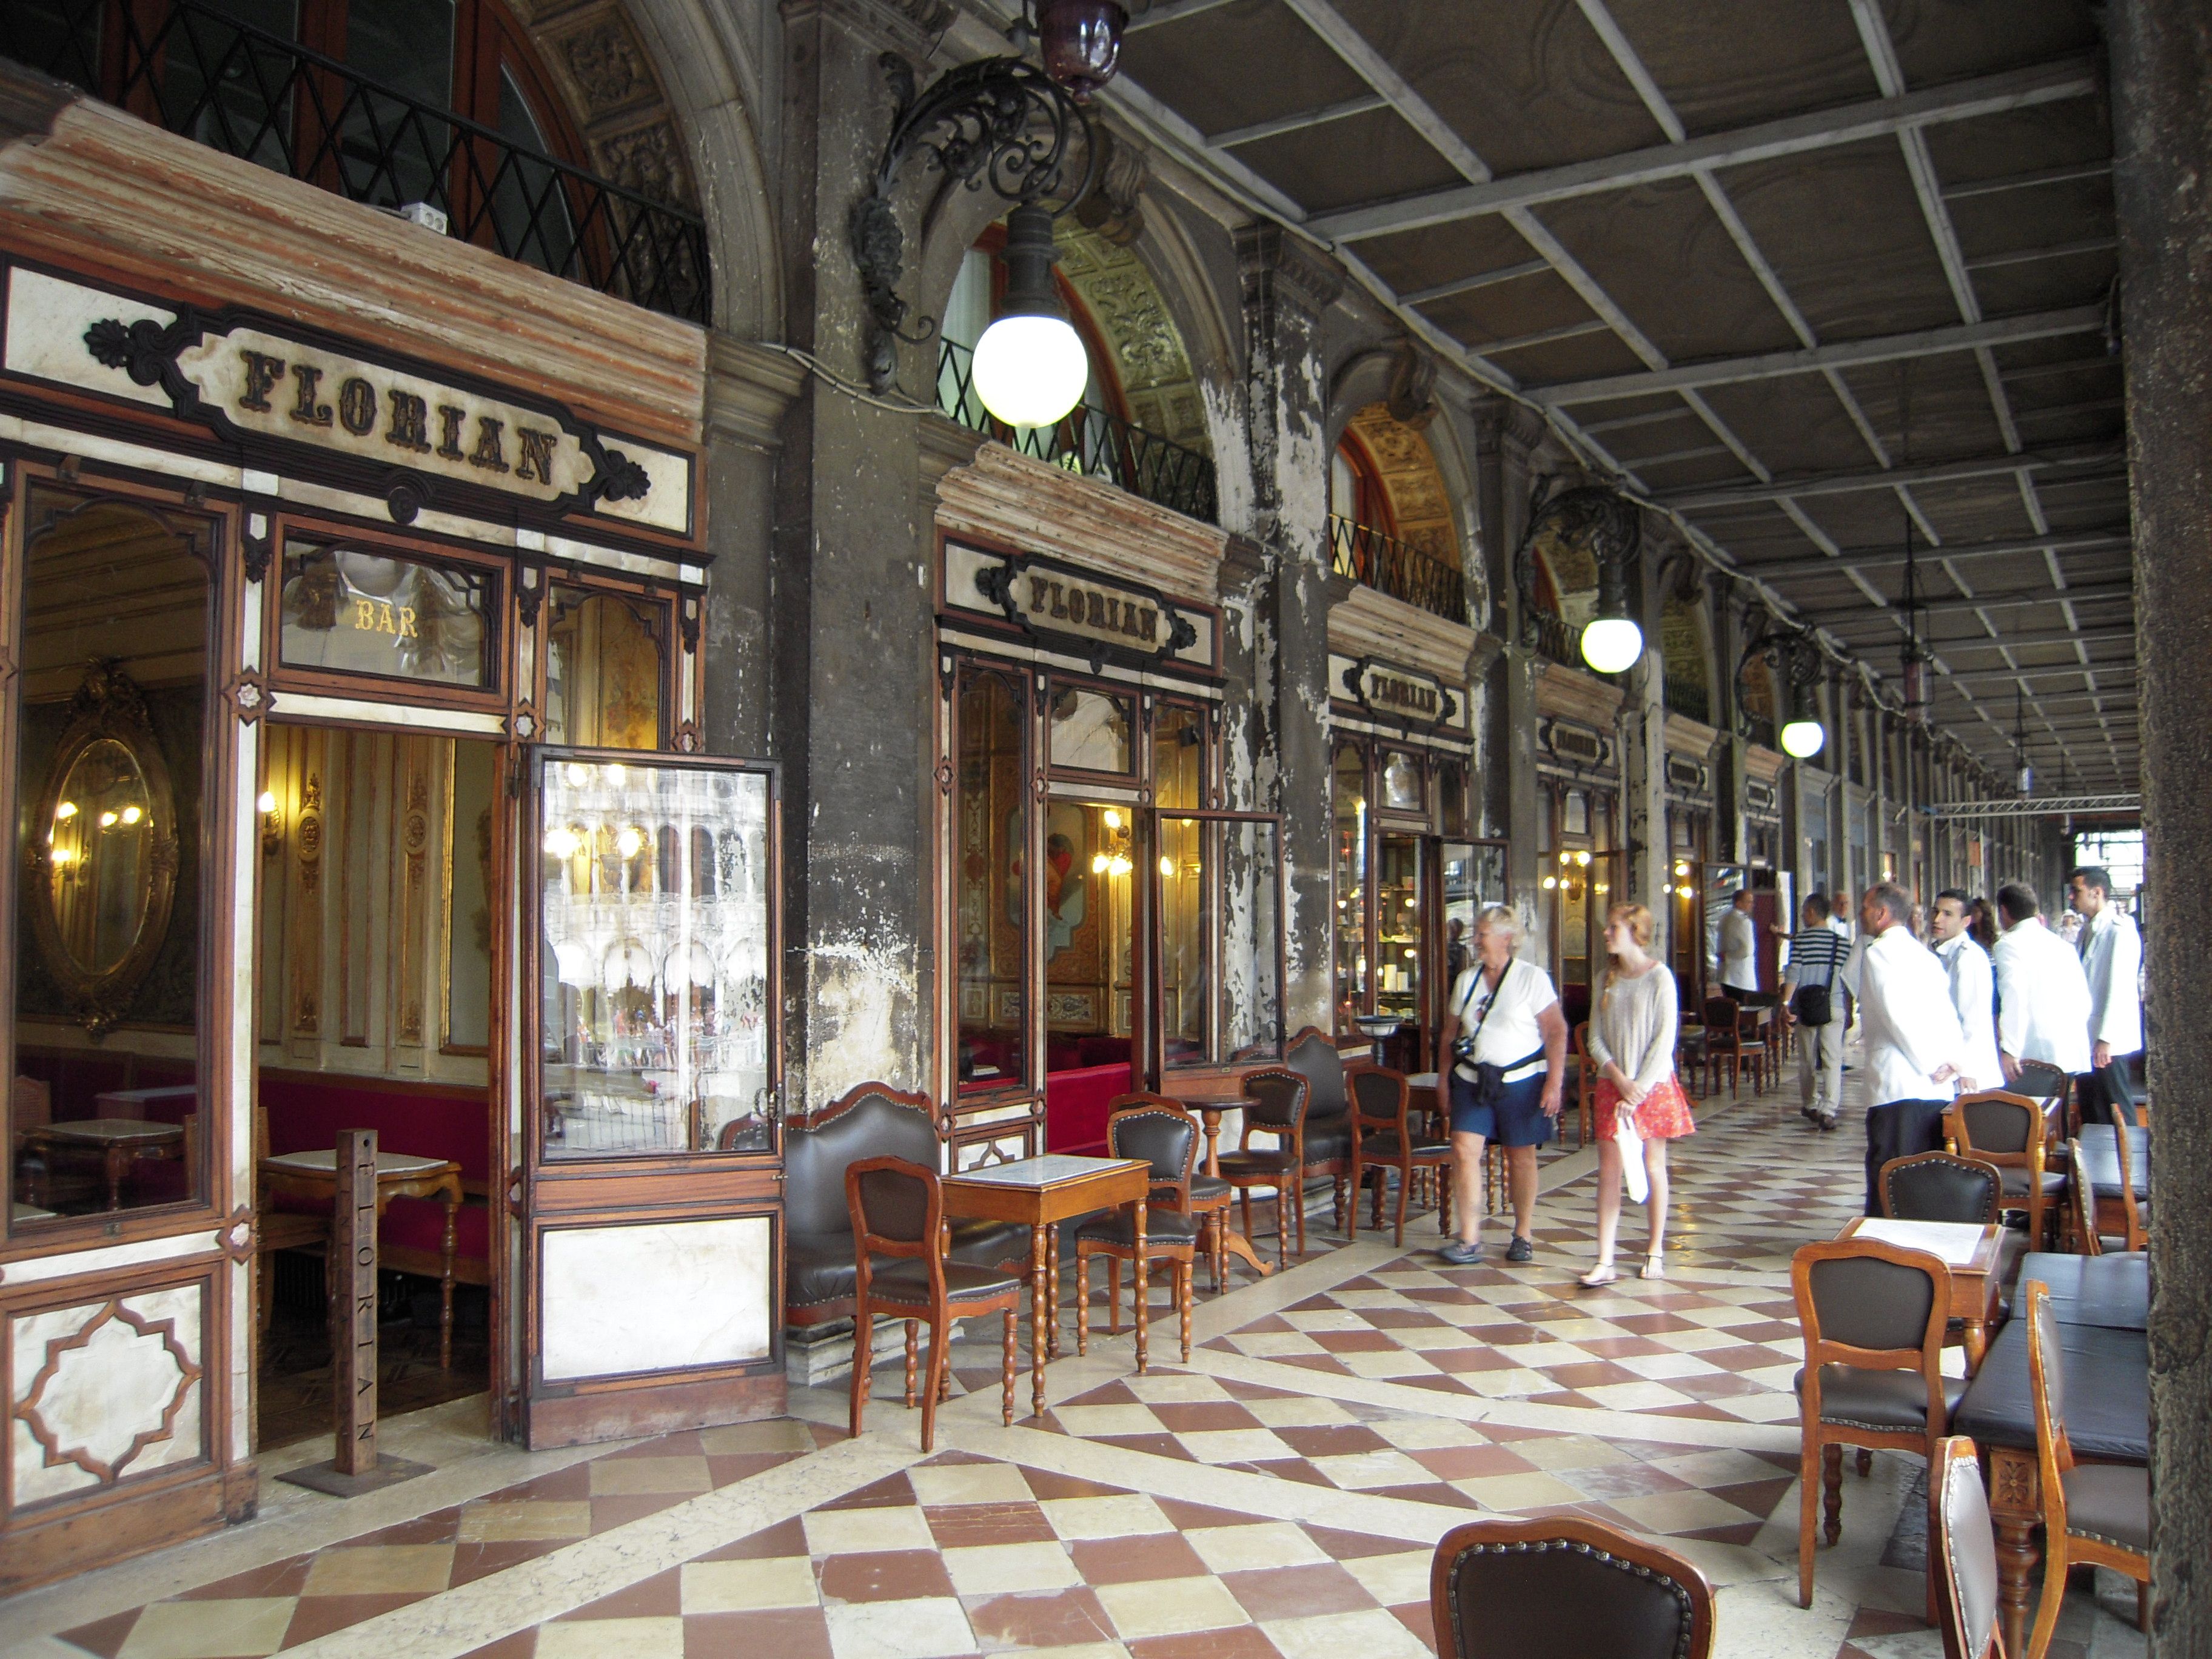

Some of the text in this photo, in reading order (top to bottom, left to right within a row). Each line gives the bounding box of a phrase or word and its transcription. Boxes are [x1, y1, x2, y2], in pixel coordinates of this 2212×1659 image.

[238, 350, 556, 484] FLORIAN
[354, 599, 418, 638] BAR
[1030, 577, 1158, 643] FLORIAN
[357, 1160, 375, 1441] FLORIAN
